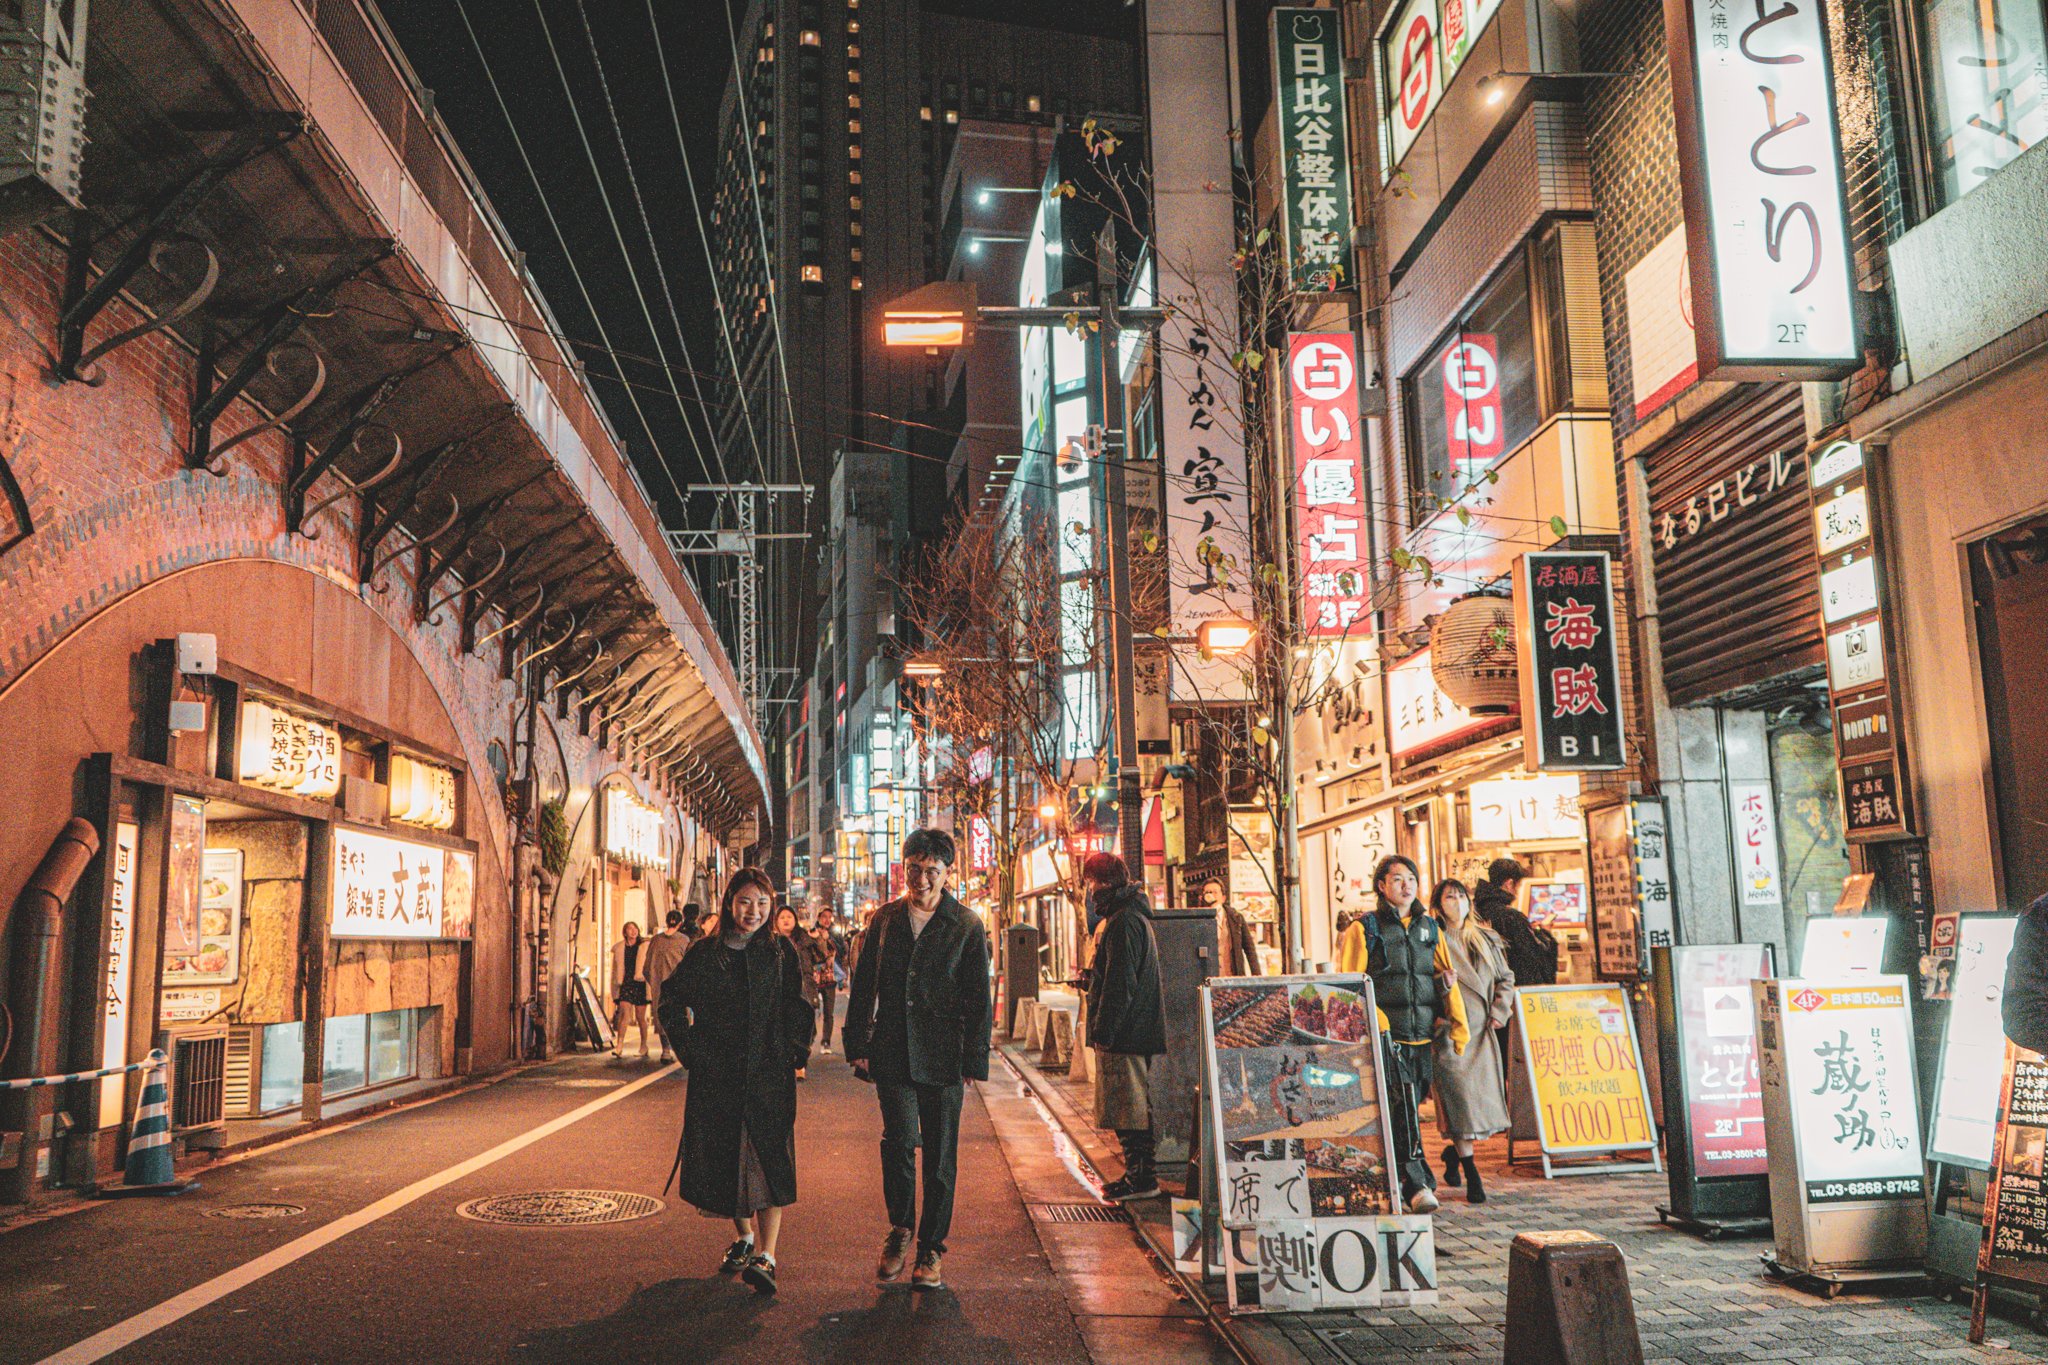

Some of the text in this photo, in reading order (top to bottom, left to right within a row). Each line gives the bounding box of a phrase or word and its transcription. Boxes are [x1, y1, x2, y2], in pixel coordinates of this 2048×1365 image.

[1293, 43, 1341, 264] 日比谷整体院
[1739, 0, 1823, 294] ととり
[1776, 323, 1808, 344] 2F
[1188, 328, 1214, 431] らーめん
[1537, 565, 1601, 587] 居酒屋
[1318, 601, 1359, 628] 3F
[1545, 597, 1609, 718] 海賊
[1843, 714, 1888, 741] DOUTOR
[271, 718, 290, 772] 炭焼き
[290, 721, 308, 775] やきとり
[1852, 779, 1884, 797] 居酒屋
[1480, 793, 1580, 822] つけ麺
[1853, 796, 1896, 825] 海賊
[1742, 792, 1767, 866] ホッピー
[1747, 889, 1776, 900] HOPPY
[1527, 996, 1558, 1014] 3階
[1799, 994, 1818, 1009] 4F
[1593, 1034, 1637, 1073] OK
[1558, 1078, 1622, 1097] 飲み放題
[1547, 1096, 1646, 1143] 1000円
[1714, 1119, 1733, 1134] 2F
[1320, 1229, 1439, 1293] OK
